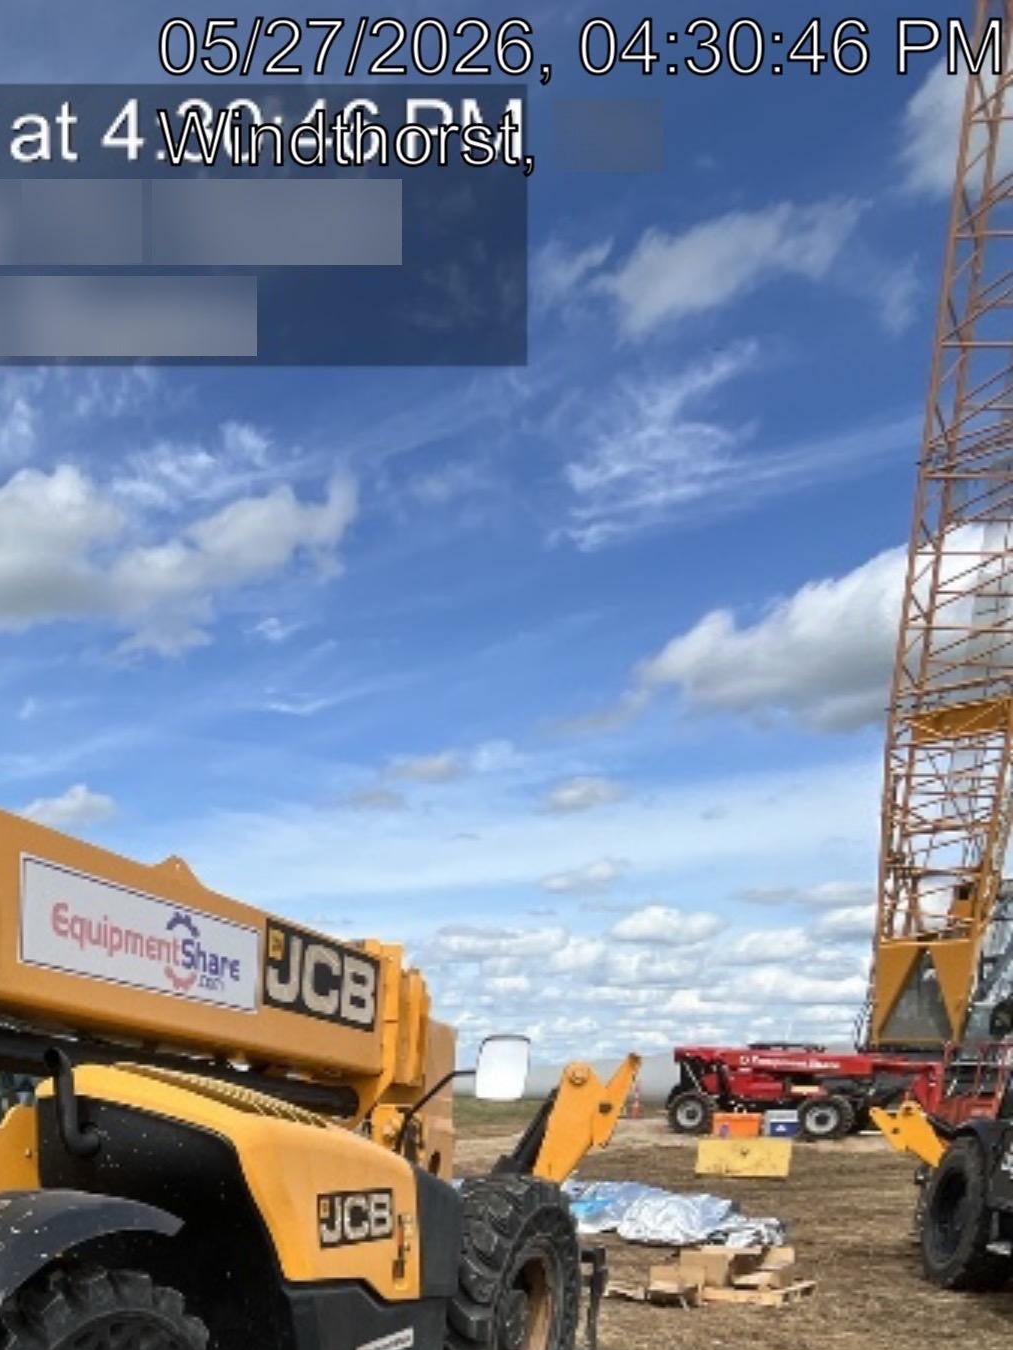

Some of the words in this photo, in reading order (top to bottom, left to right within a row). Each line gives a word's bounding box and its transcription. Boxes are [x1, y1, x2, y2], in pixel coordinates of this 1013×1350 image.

[51, 901, 241, 982] EquipmentShare
[266, 934, 375, 1024] JCB
[320, 1193, 392, 1243] JCB
